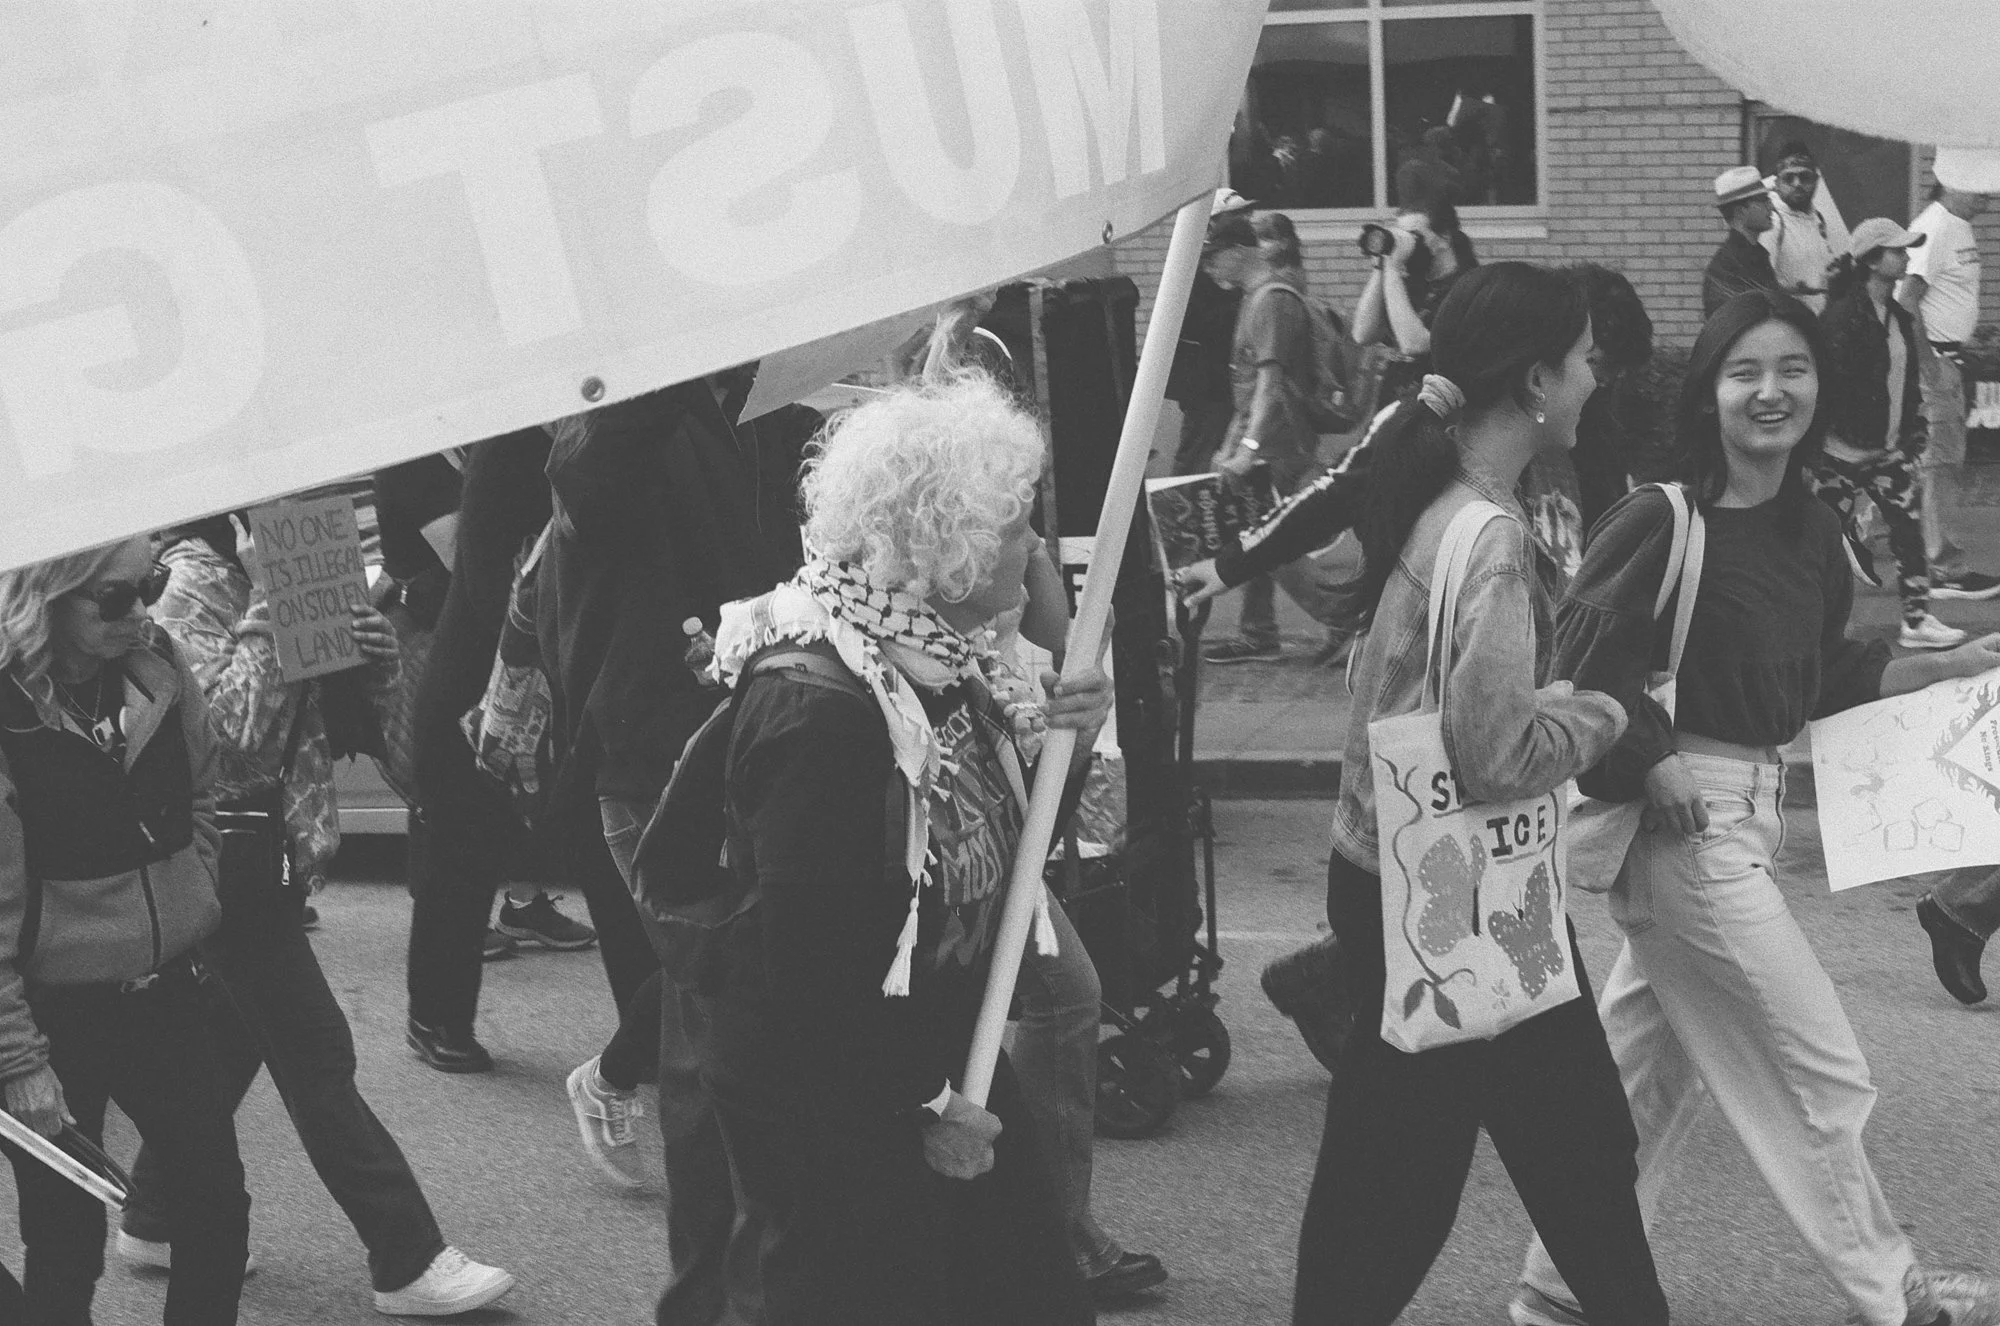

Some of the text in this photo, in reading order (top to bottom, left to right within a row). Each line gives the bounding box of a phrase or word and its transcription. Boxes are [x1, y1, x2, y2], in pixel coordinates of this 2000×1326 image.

[259, 508, 349, 553] NO ONE
[263, 546, 365, 594] IS ILLEGAL
[277, 596, 305, 628] ON
[1486, 804, 1547, 858] ICE
